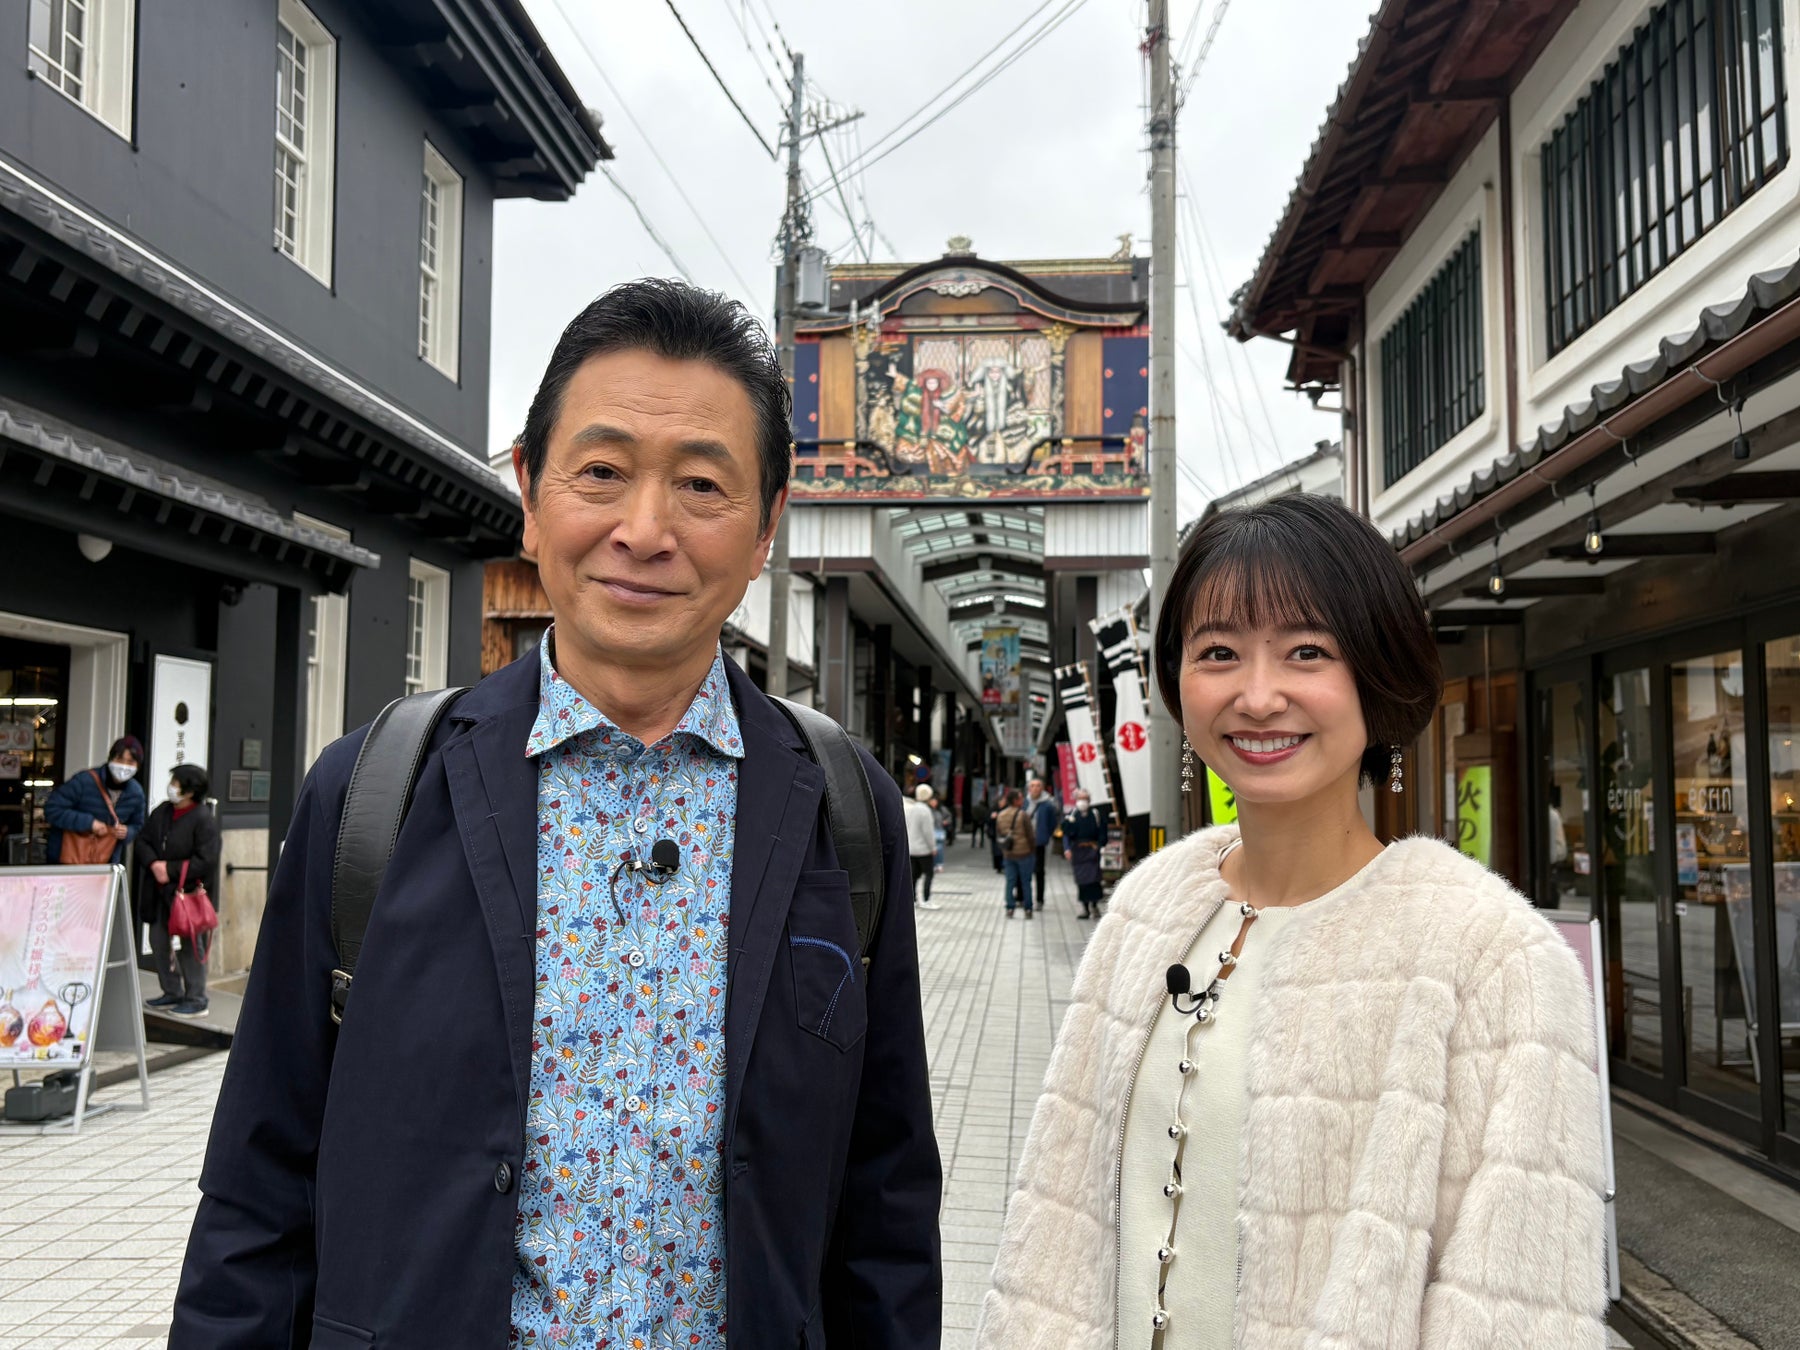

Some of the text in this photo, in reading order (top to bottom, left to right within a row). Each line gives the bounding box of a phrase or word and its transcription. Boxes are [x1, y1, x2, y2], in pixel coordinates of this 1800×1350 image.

[1608, 780, 1641, 810] écrin
[1688, 779, 1732, 812] écrin
[1458, 780, 1482, 857] 火の
